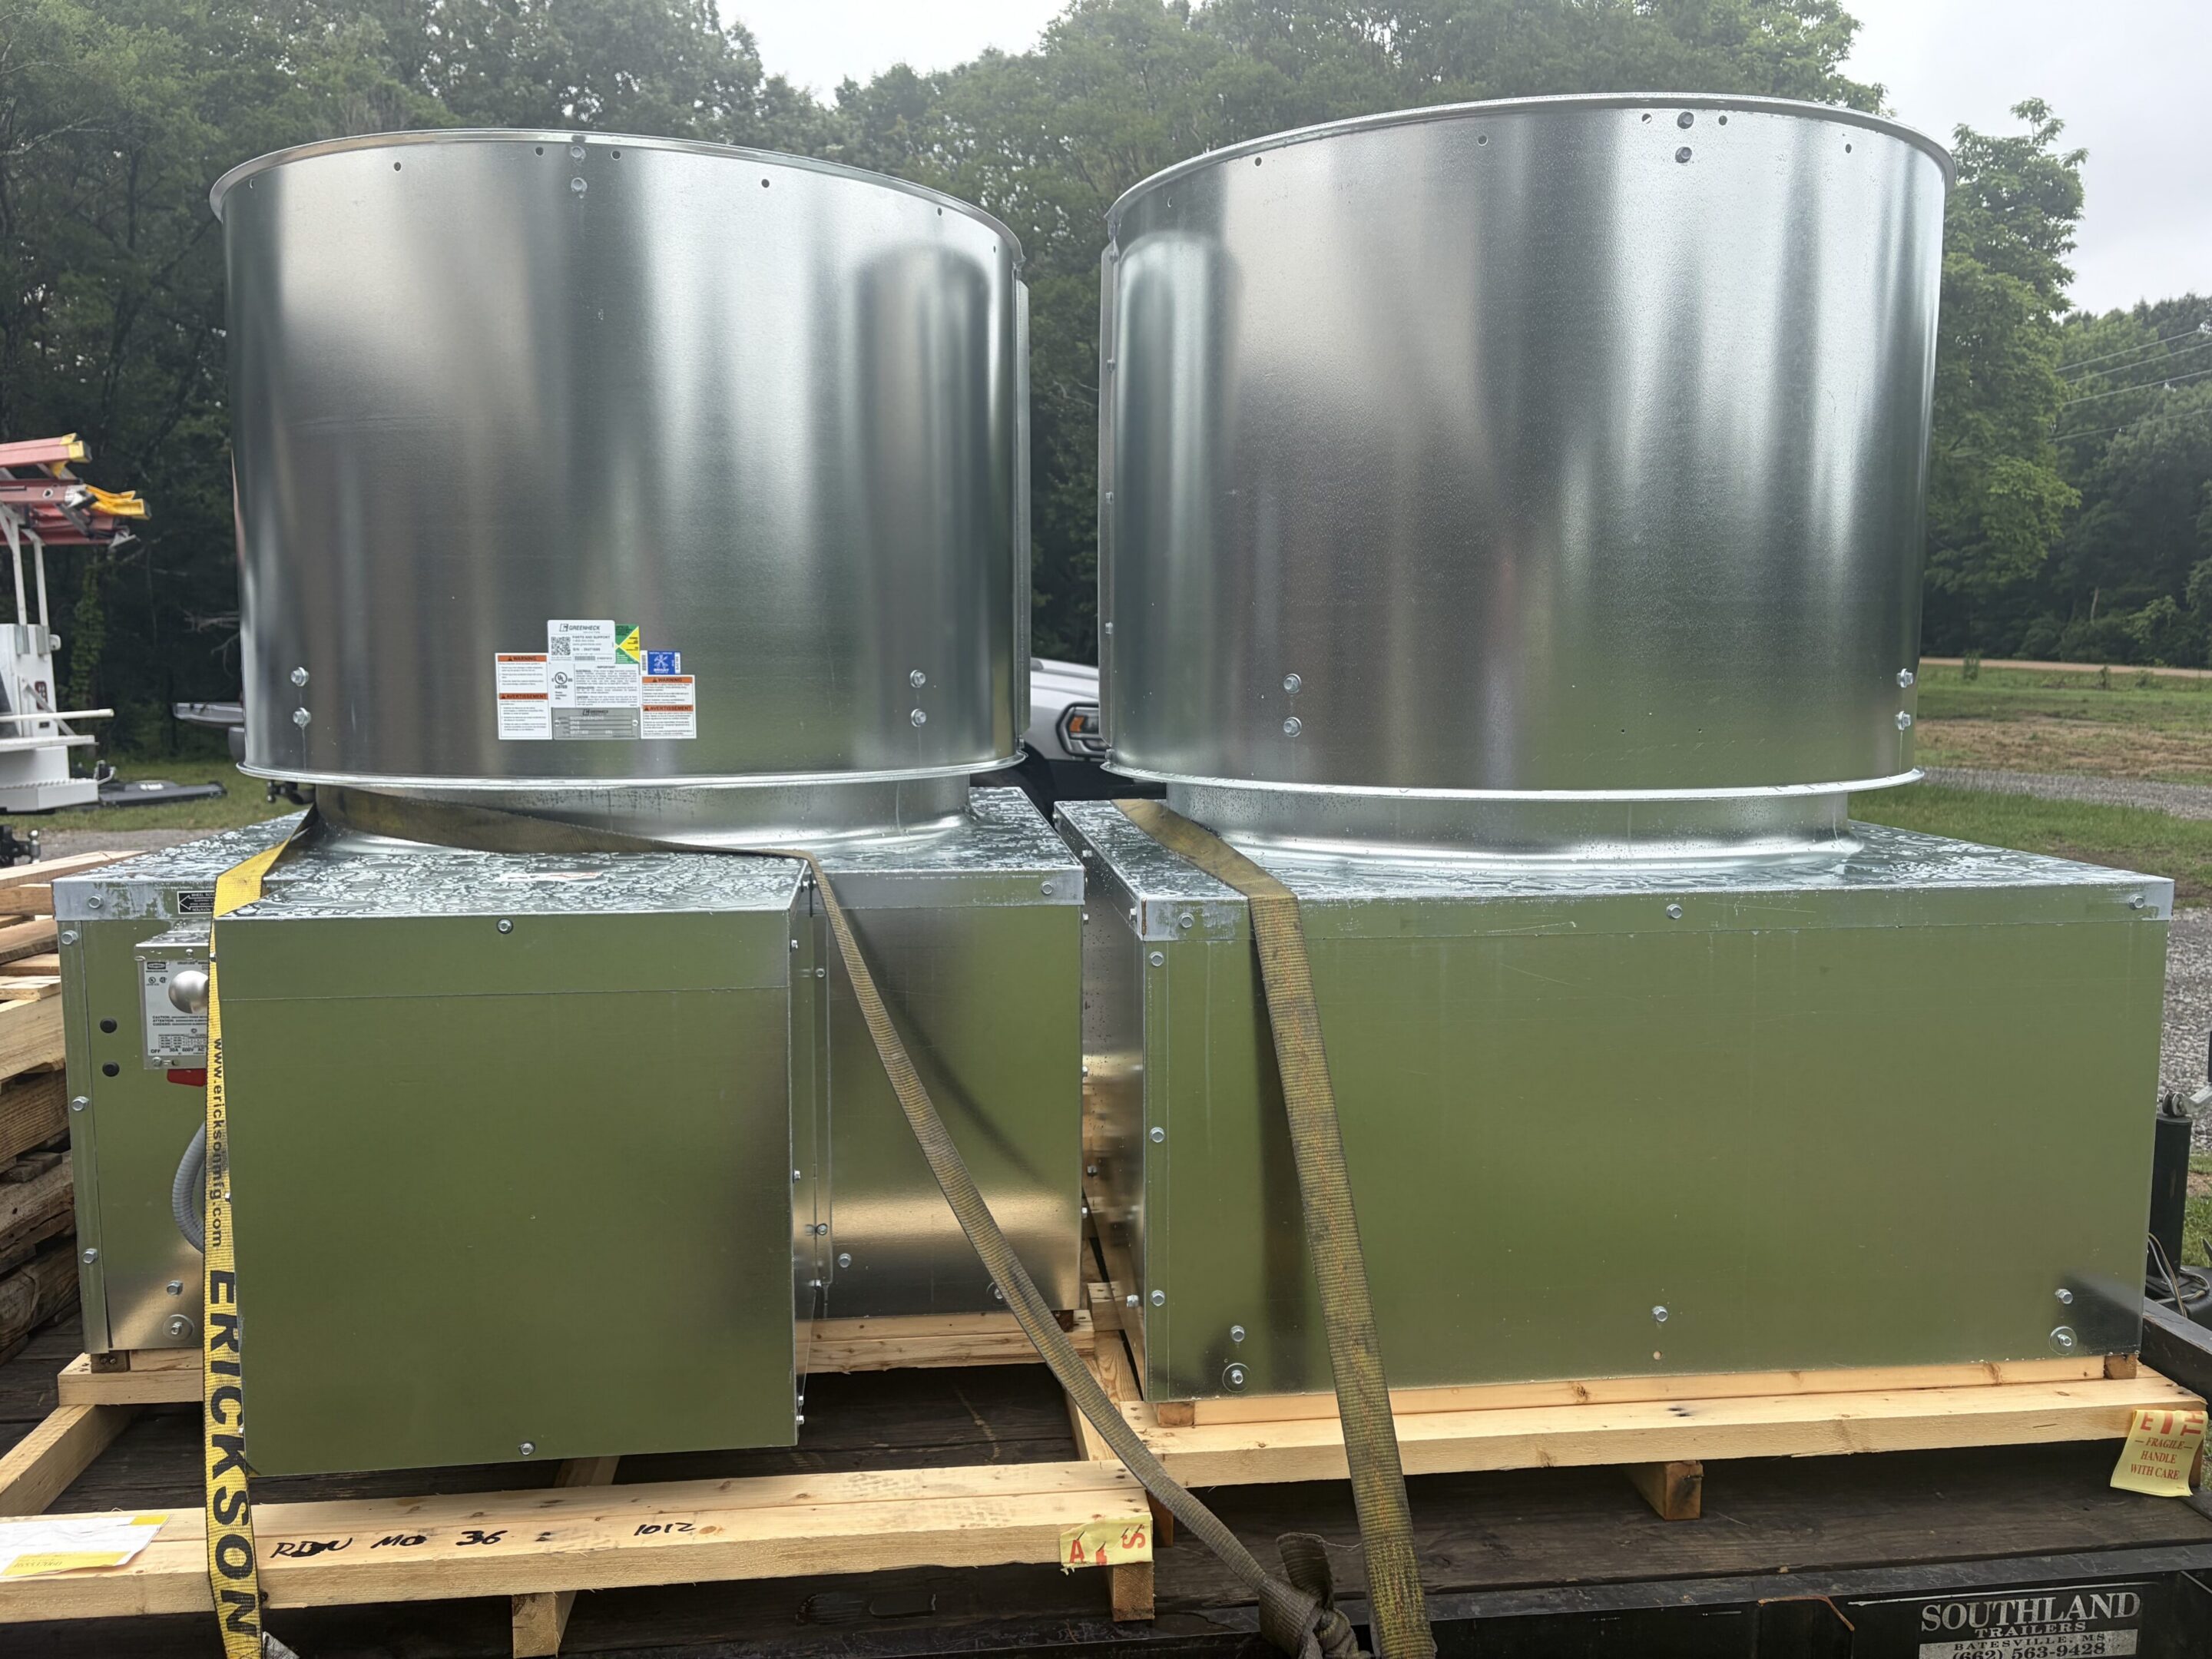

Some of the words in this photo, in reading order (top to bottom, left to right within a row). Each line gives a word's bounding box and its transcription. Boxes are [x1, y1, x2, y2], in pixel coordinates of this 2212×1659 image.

[210, 1038, 225, 1247] www.ericksonmfg.com
[2145, 1437, 2185, 1450] FRAGILE
[209, 1270, 257, 1638] ERICKSON
[2141, 1450, 2177, 1465] HANDLE
[2131, 1464, 2154, 1476] WITH
[2154, 1467, 2180, 1480] CARE
[634, 1522, 697, 1536] 1012
[1921, 1591, 2141, 1632] SOUTHLAND
[1975, 1621, 2086, 1639] TRAILERS
[2012, 1642, 2106, 1659] 563-9428
